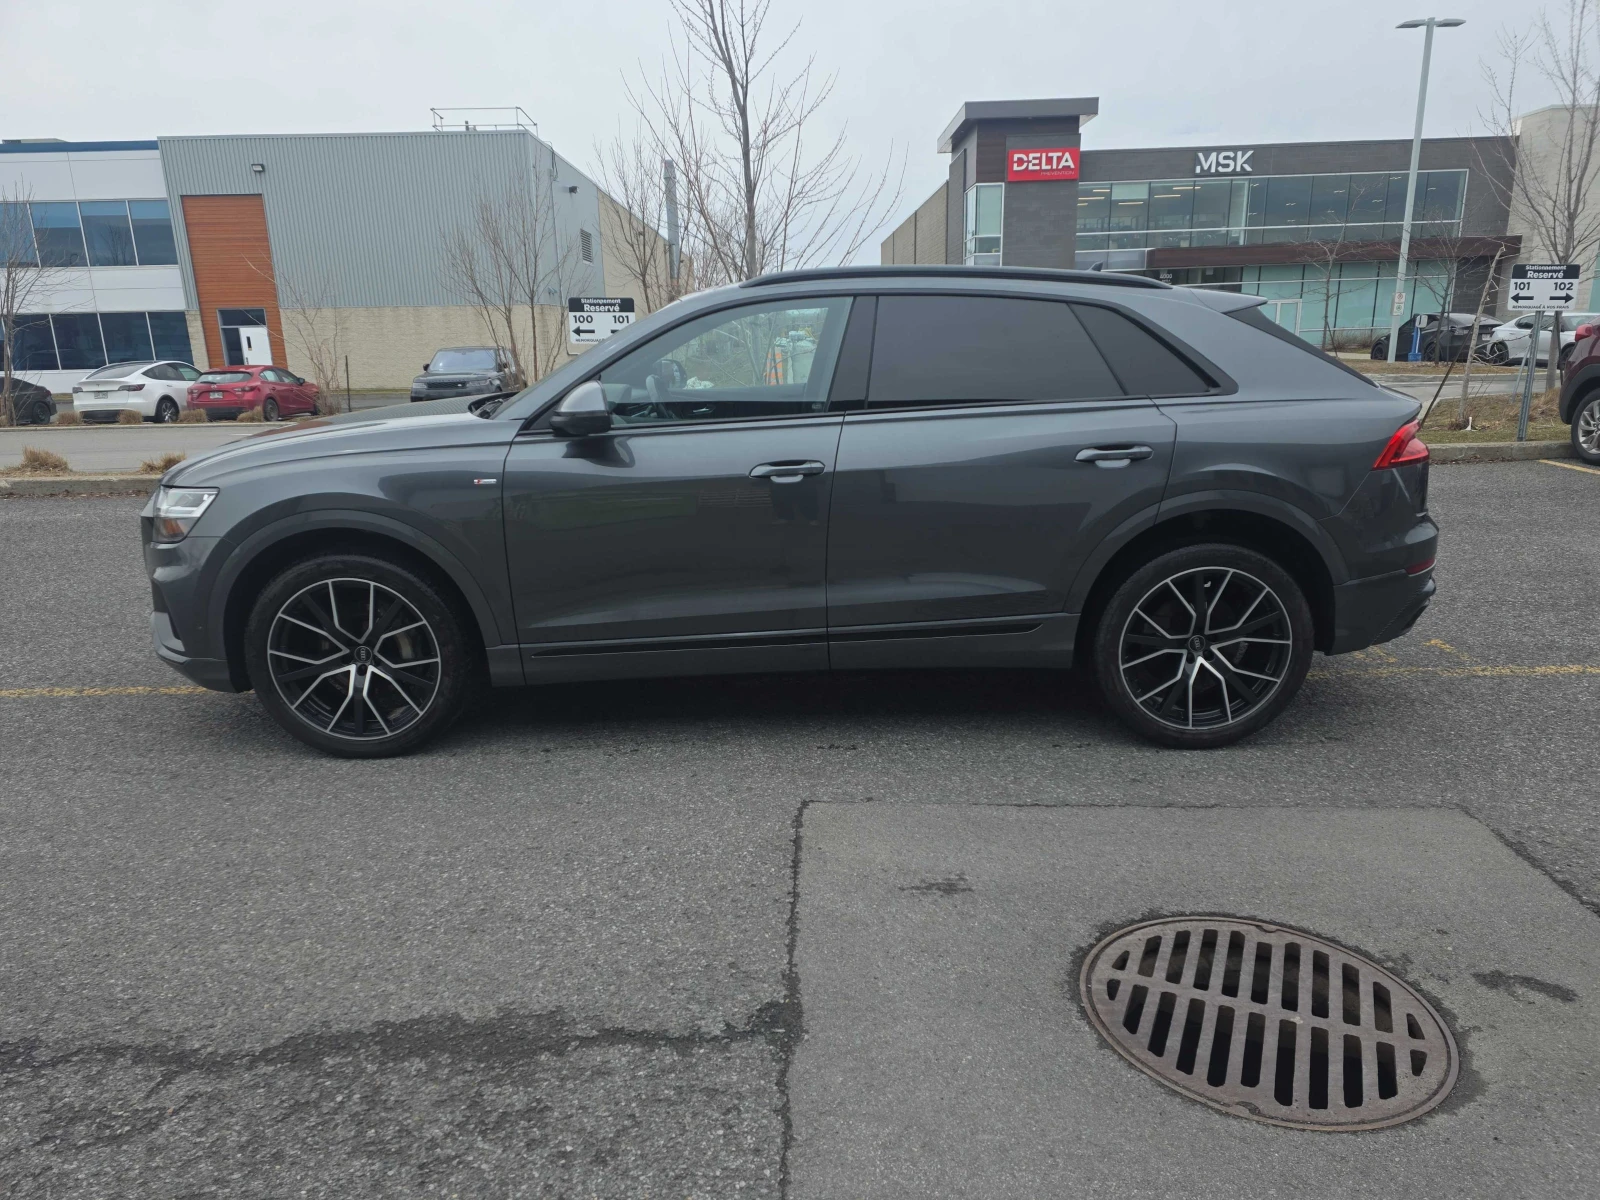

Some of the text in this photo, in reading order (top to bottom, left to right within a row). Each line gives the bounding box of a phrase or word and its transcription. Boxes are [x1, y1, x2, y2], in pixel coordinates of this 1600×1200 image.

[1013, 152, 1075, 171] DELTA
[1195, 150, 1254, 173] MSK
[1527, 270, 1564, 278] Reservé
[1513, 281, 1574, 291] 101 102
[583, 304, 620, 312] Reservé
[573, 315, 630, 324] 100 101
